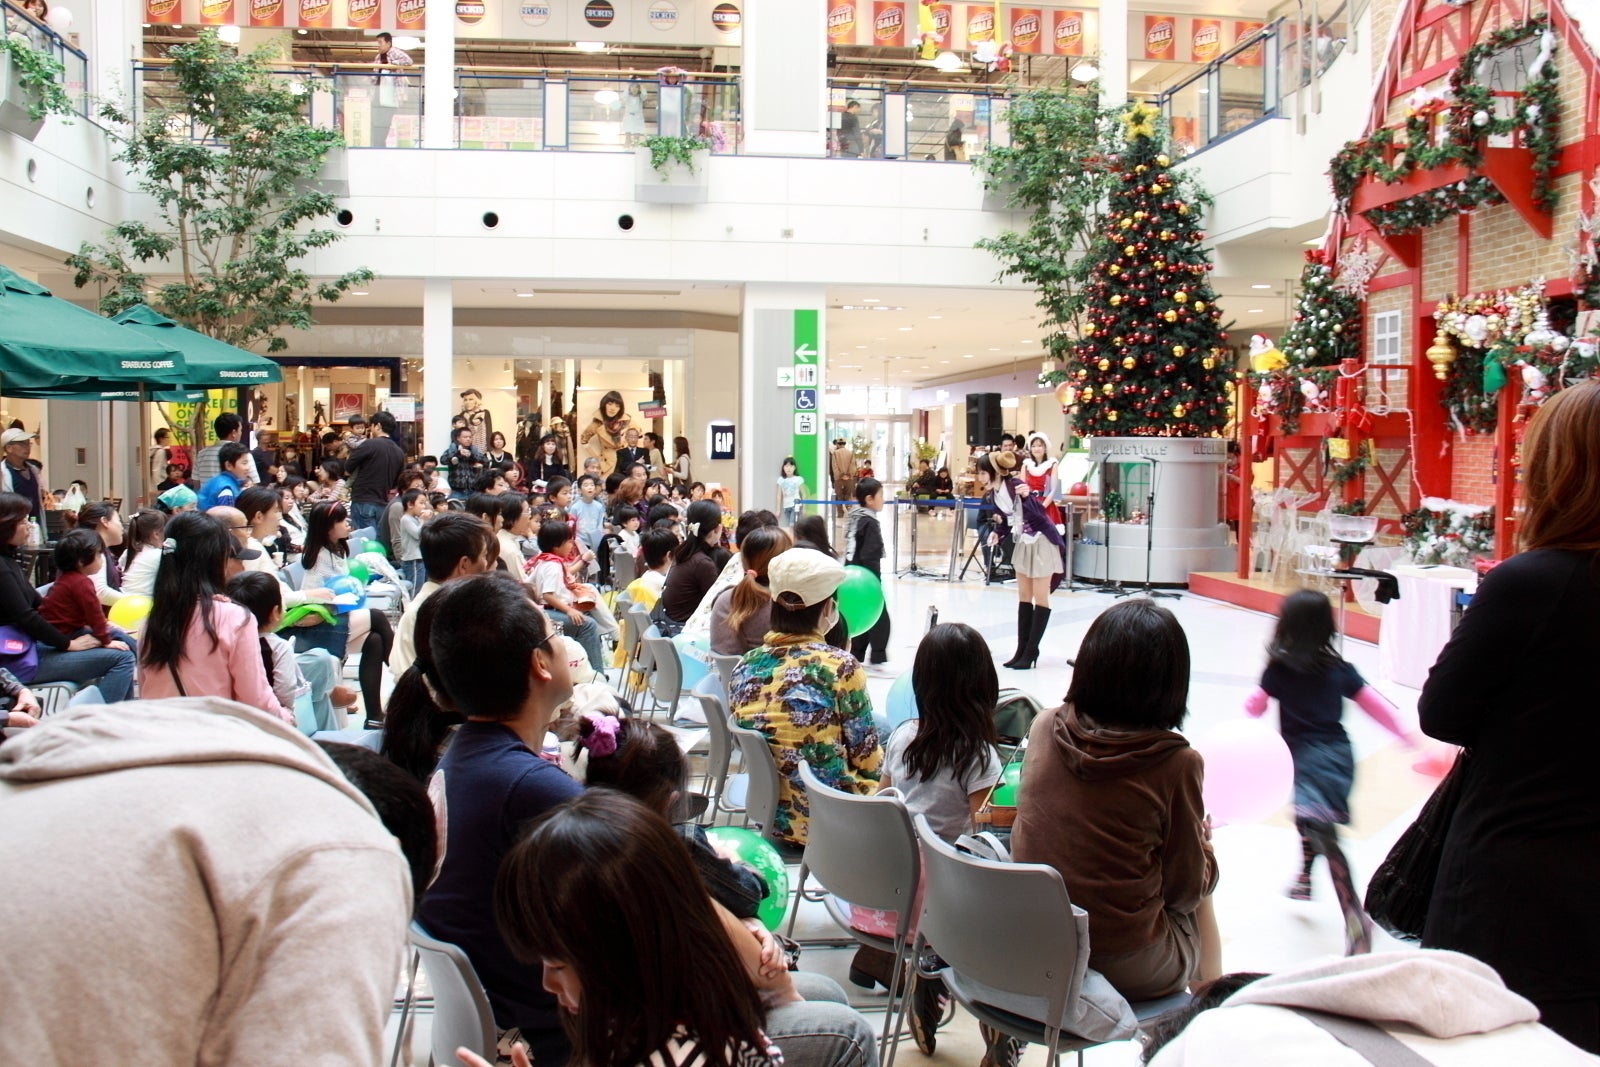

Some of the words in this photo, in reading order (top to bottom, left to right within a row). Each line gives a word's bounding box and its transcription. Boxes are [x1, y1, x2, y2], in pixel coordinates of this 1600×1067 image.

[352, 0, 376, 11] SALE
[400, 0, 425, 12] SALE
[457, 5, 484, 14] SPORTS
[522, 7, 548, 15] SPORTS
[586, 9, 613, 17] SPORTS
[650, 11, 677, 19] SPORTS
[713, 13, 740, 22] SPORTS
[829, 13, 853, 27] SALE
[876, 14, 900, 30] SALE
[969, 20, 993, 34] SALE
[1014, 21, 1037, 37] SALE
[1056, 23, 1080, 39] SALE
[1149, 29, 1171, 43] SALE
[1195, 31, 1218, 46] SALE
[121, 360, 151, 369] STARBUCKS
[152, 360, 175, 368] COFFEE
[219, 370, 248, 378] STARBUCKS
[715, 432, 733, 453] GAP
